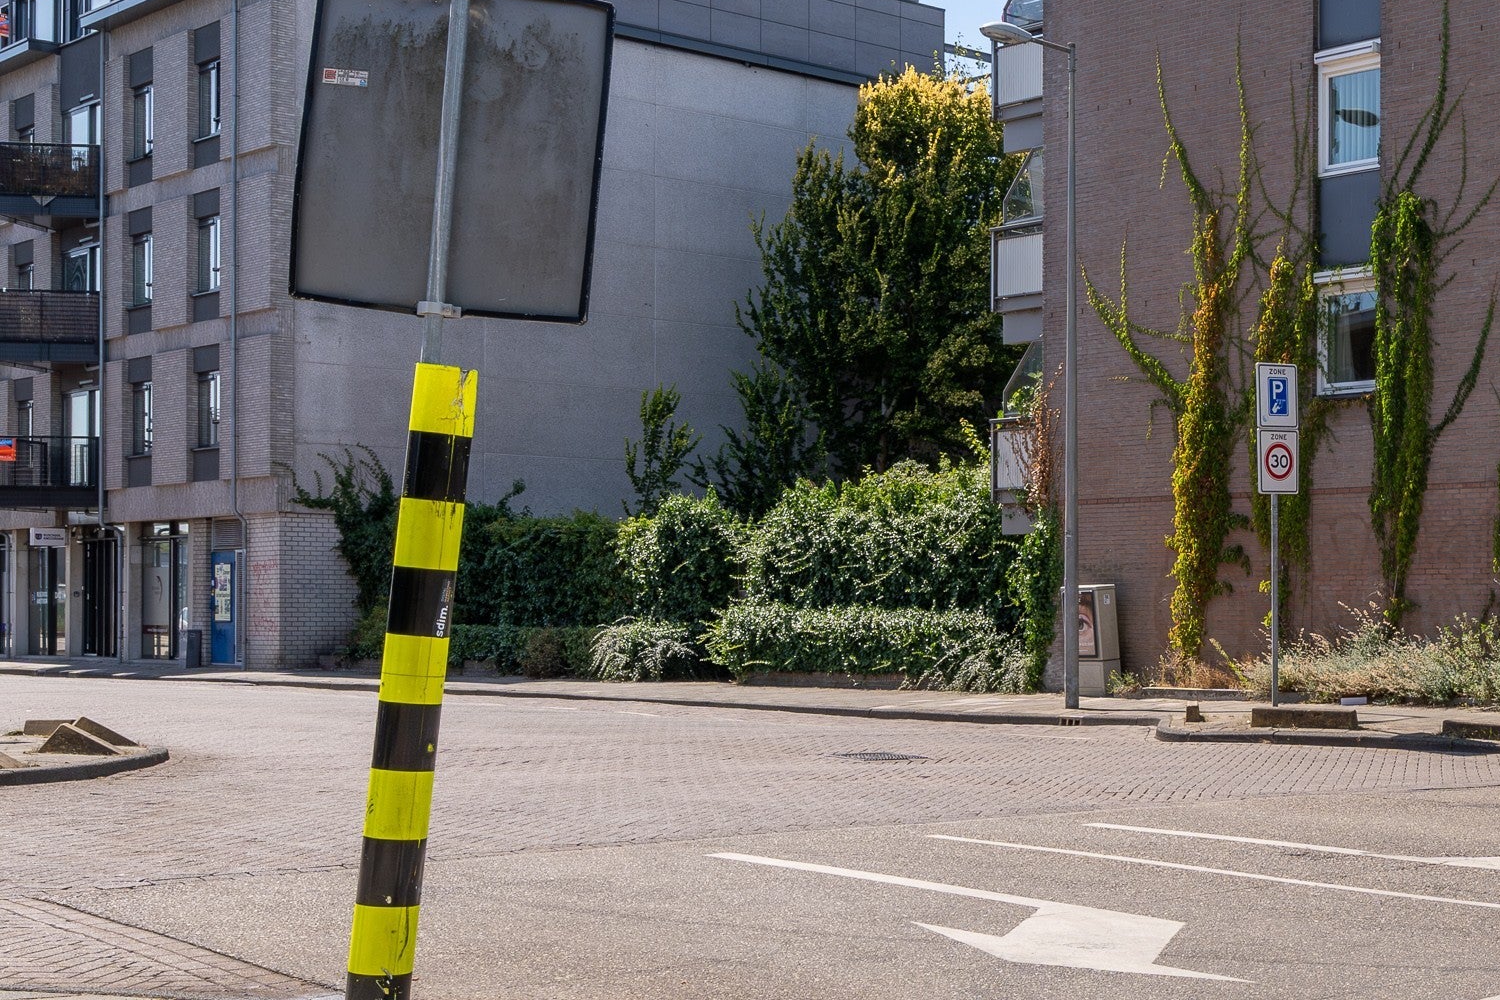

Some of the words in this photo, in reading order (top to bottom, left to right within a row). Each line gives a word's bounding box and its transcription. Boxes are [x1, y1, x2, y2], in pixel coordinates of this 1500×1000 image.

[1272, 381, 1283, 399] P
[1271, 455, 1288, 468] 30
[436, 605, 448, 637] sdim.
